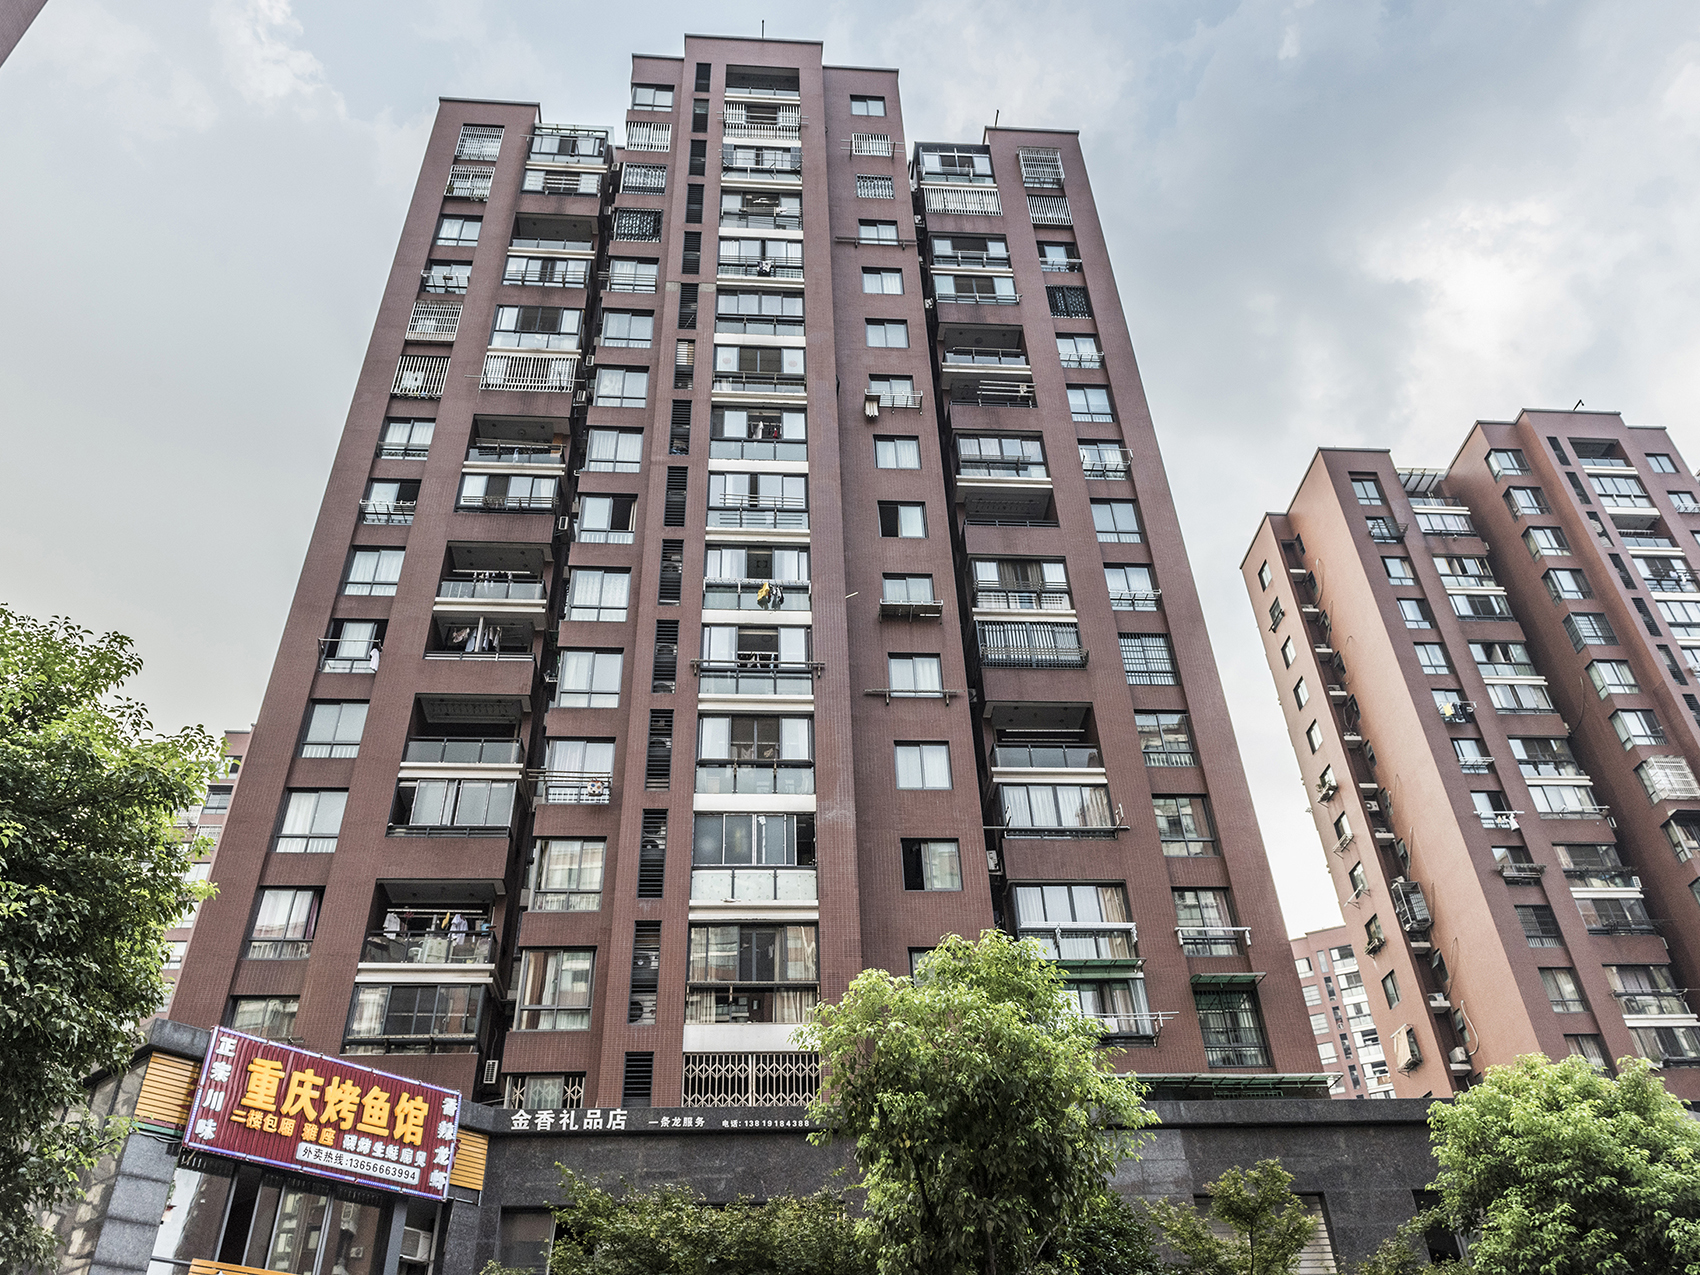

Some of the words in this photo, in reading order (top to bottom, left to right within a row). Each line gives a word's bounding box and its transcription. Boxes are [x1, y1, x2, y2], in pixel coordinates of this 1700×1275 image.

[195, 1036, 238, 1140] 正宗川味
[230, 1109, 296, 1137] 二楼包厢
[301, 1122, 336, 1146] 雅座
[240, 1057, 429, 1147] 重庆烤鱼馆
[510, 1108, 628, 1131] 金香礼品店
[648, 1116, 706, 1128] 一条龙服务
[429, 1097, 458, 1190] 香辣龙虾
